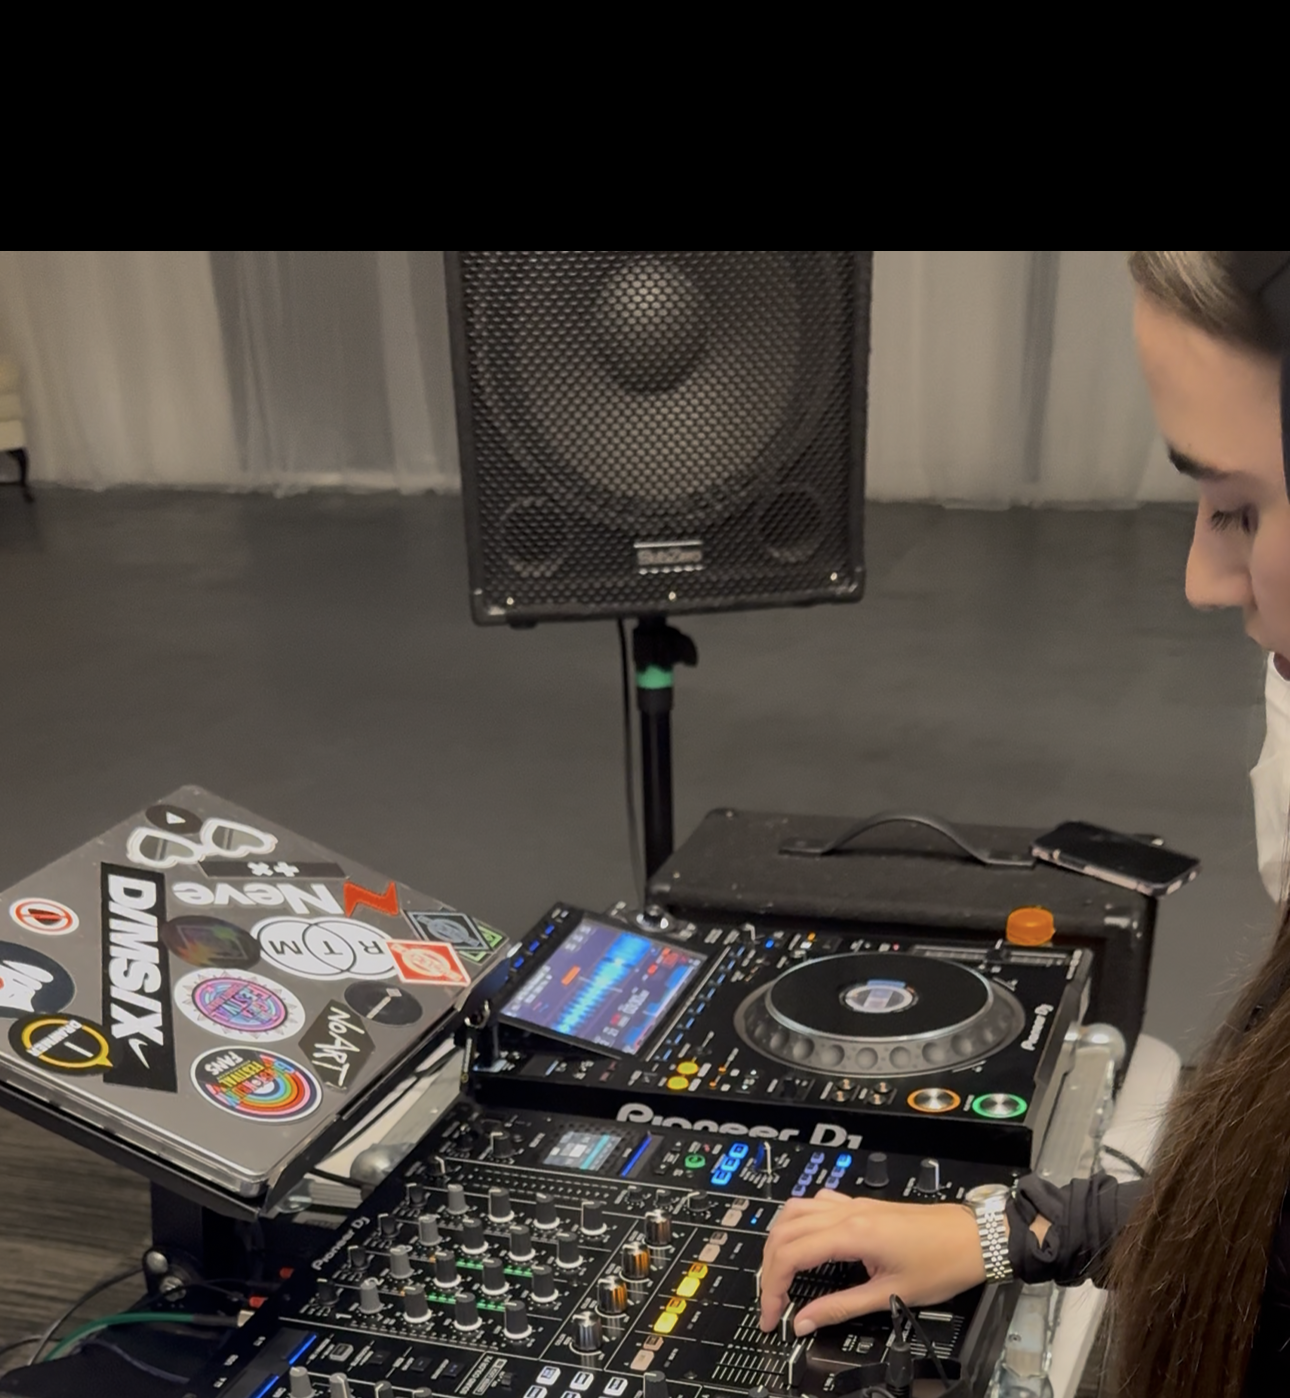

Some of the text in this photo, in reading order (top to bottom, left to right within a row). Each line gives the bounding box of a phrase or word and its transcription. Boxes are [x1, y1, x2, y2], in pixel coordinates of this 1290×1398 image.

[171, 882, 344, 914] Neve
[269, 940, 385, 955] R T M
[204, 1050, 244, 1076] FANS
[311, 1216, 371, 1271] Pioneer Dj
